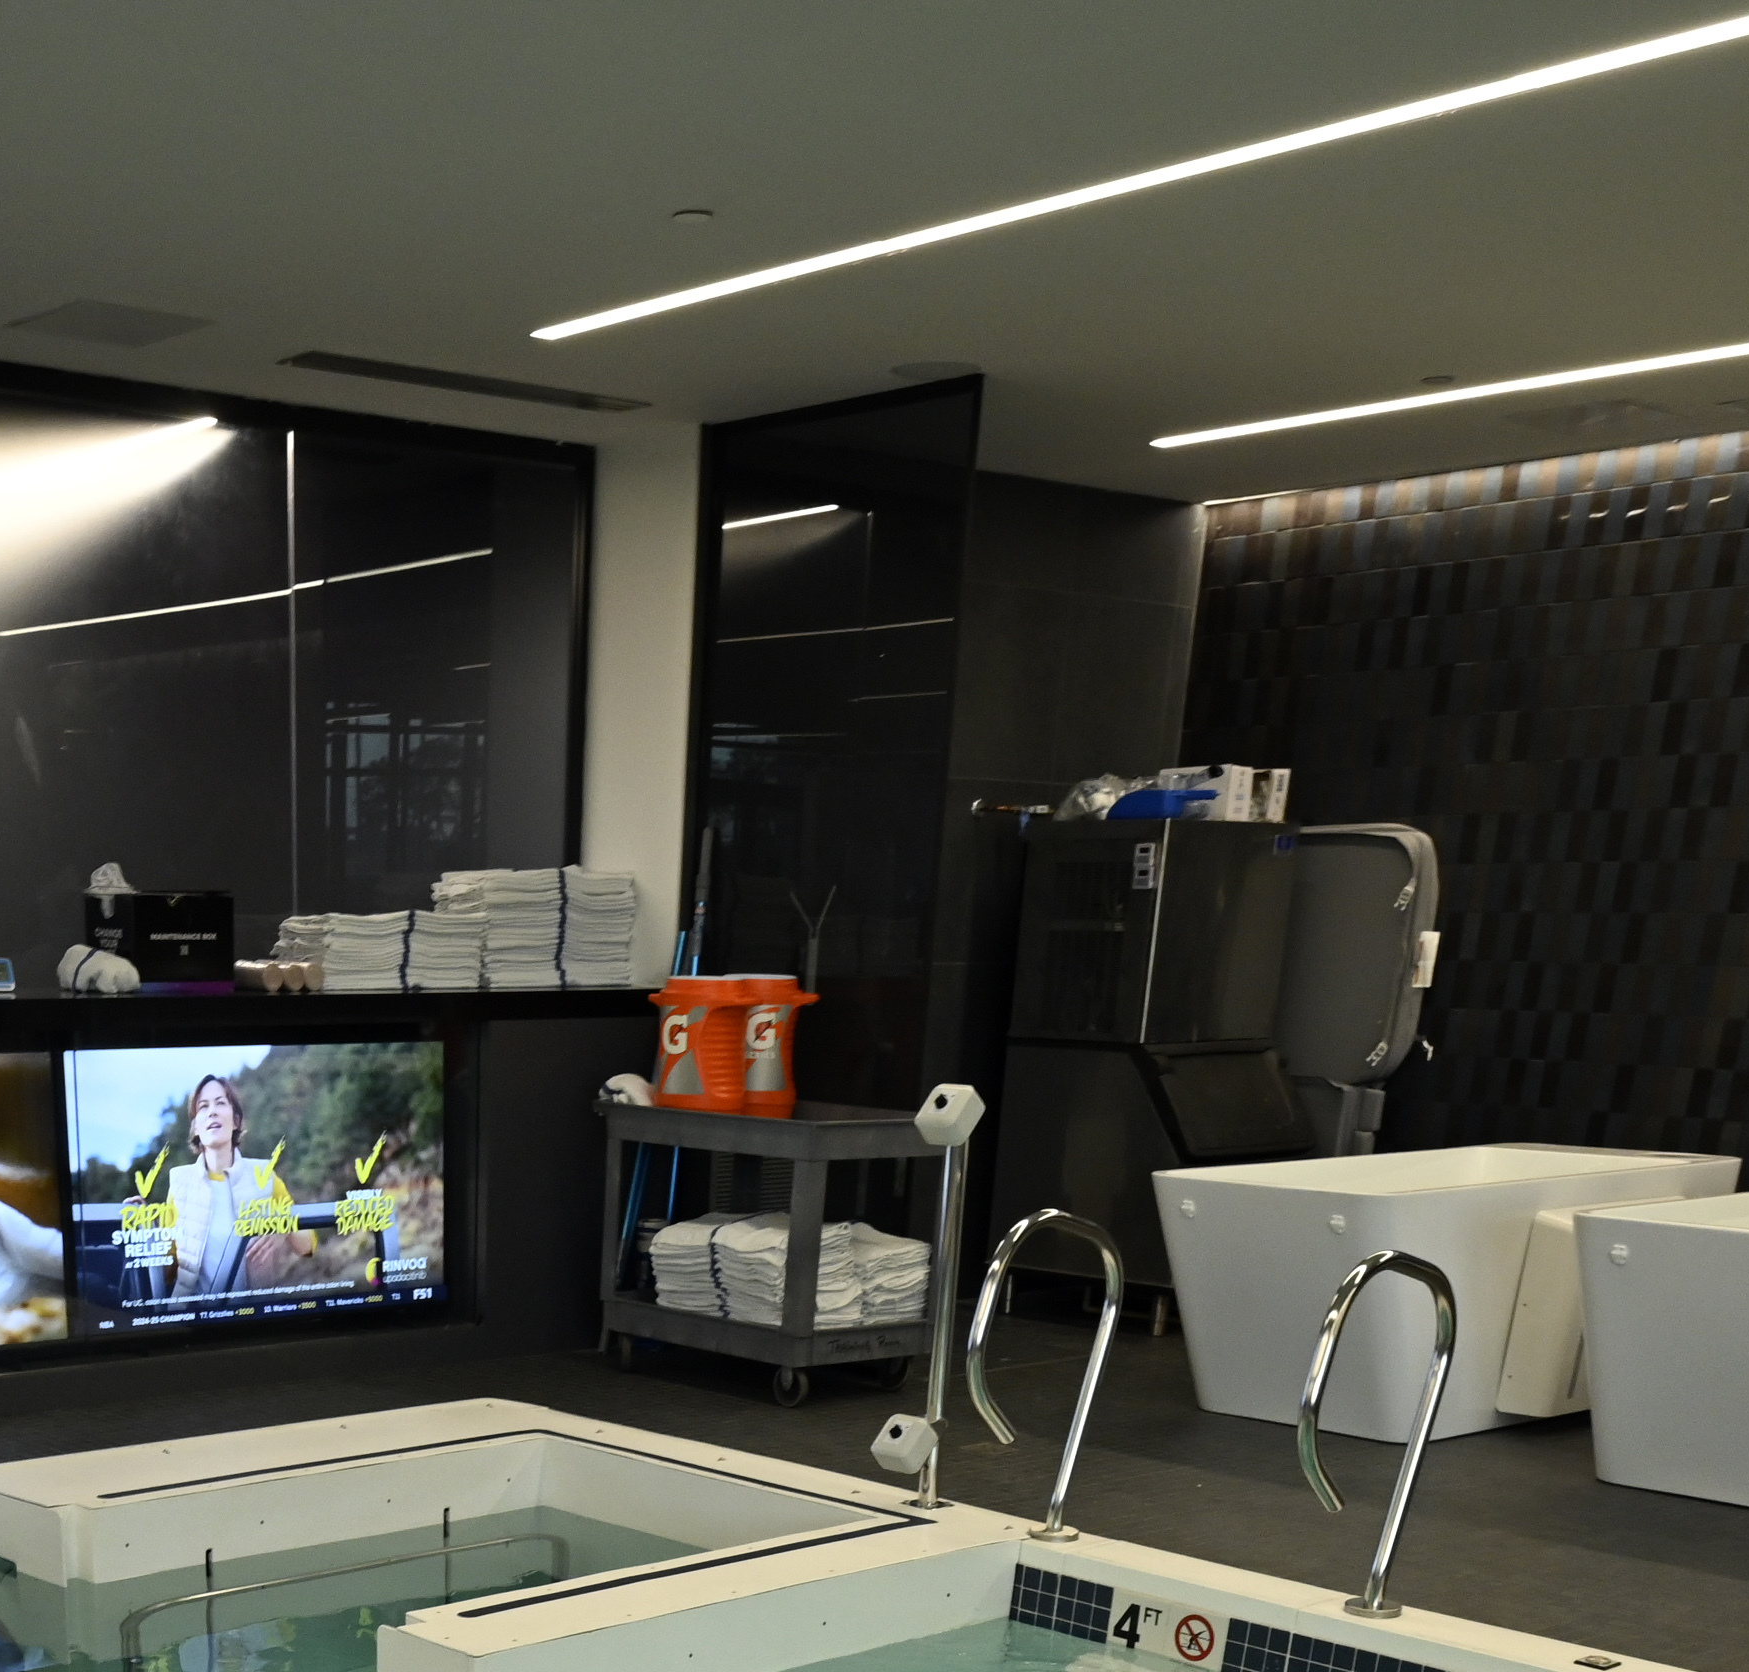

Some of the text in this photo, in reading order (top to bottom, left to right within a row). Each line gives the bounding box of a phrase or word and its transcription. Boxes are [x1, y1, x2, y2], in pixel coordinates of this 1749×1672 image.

[662, 1014, 689, 1055] G
[746, 1012, 777, 1050] G
[346, 1188, 383, 1201] VISIBLY
[120, 1202, 178, 1231] RAPID
[237, 1196, 295, 1219] LASTING
[334, 1195, 396, 1218] REDUCED
[234, 1214, 301, 1238] REMISSION
[336, 1210, 394, 1236] DAMAGE
[111, 1227, 183, 1246] SYMPTOM
[124, 1241, 173, 1259] RELIEF
[143, 1255, 175, 1268] WEEKS
[382, 1258, 427, 1273] RINVOQ
[413, 1287, 433, 1301] FS1
[159, 1311, 196, 1324] CHAMPION
[273, 1303, 298, 1312] Warriors
[336, 1296, 364, 1306] Mavericks
[1113, 1603, 1163, 1649] 4 FT
